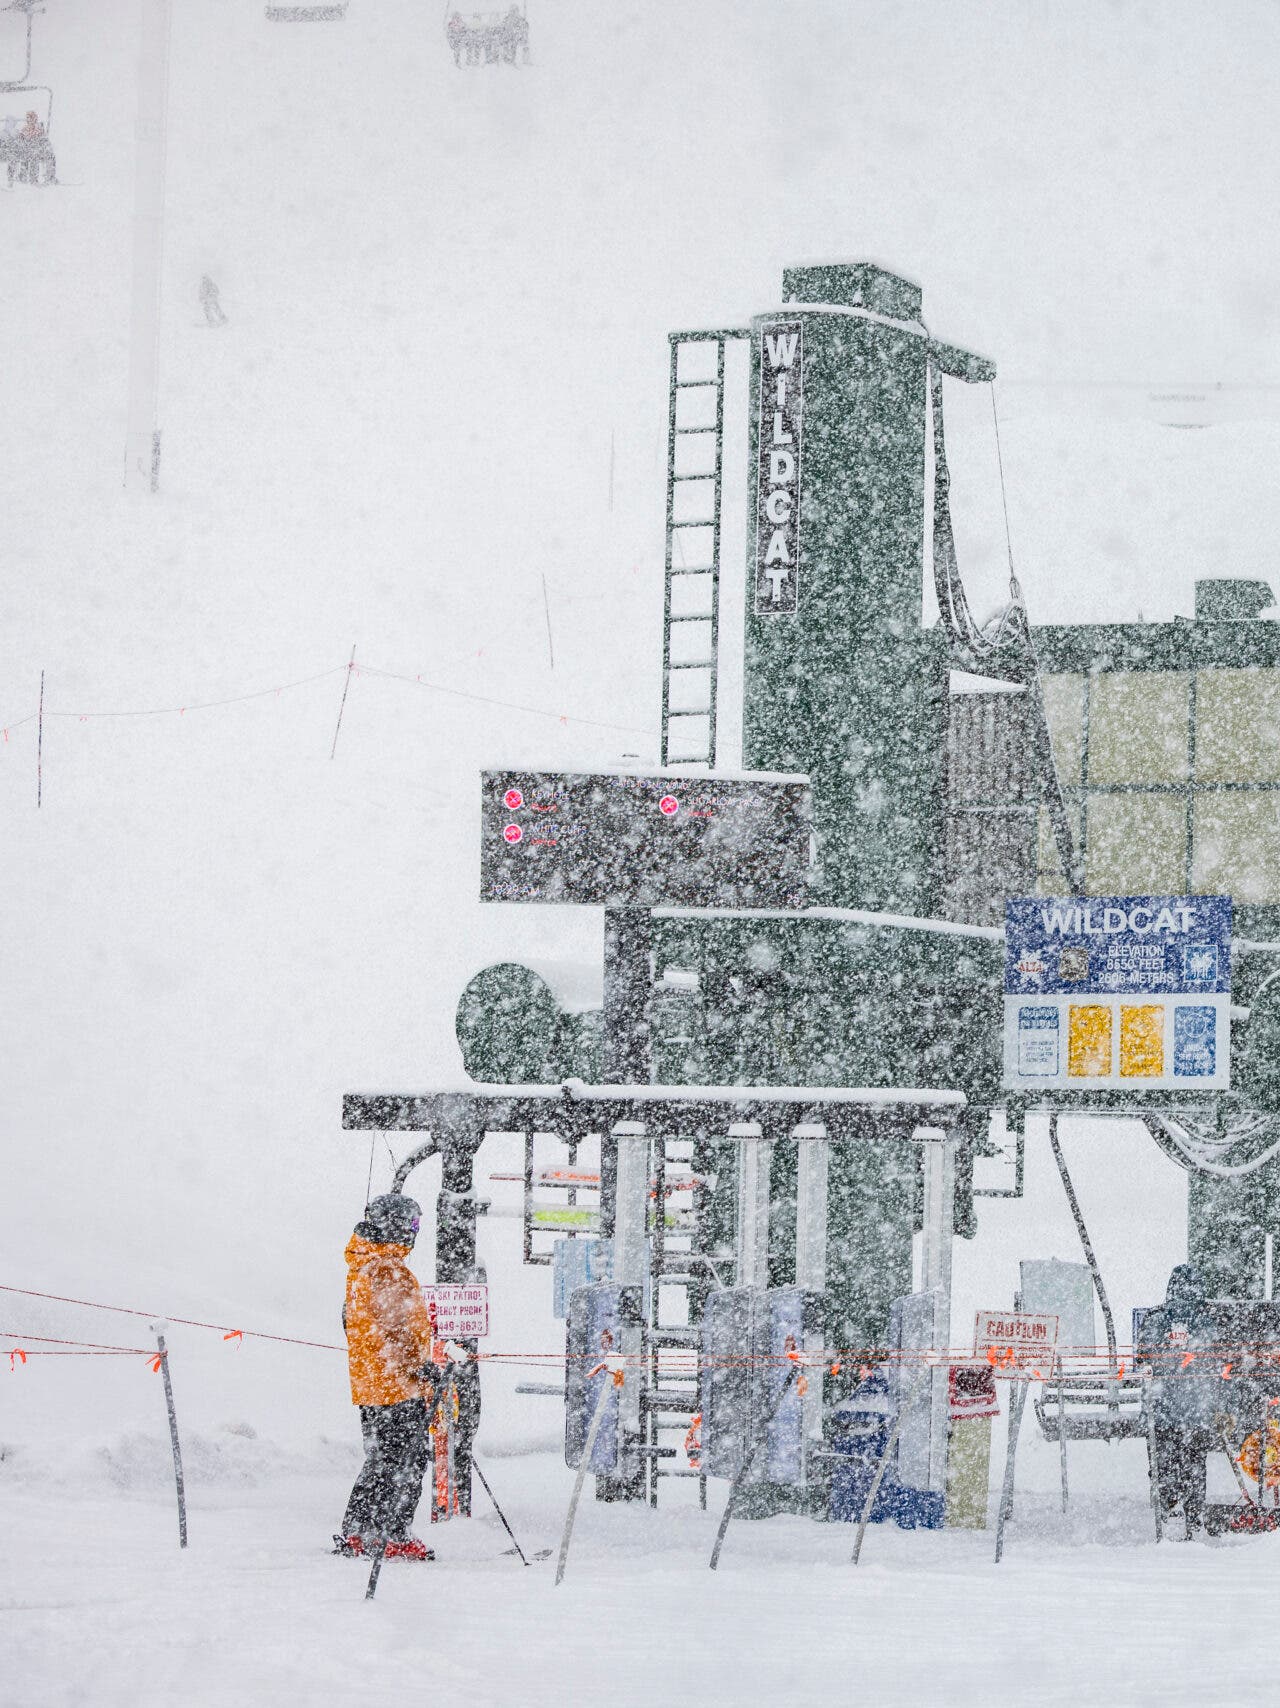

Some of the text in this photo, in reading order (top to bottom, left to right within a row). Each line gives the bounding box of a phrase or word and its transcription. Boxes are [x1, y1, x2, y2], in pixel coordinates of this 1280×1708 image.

[764, 333, 799, 602] WILDCAT
[1041, 906, 1197, 935] WILDCAT
[1108, 945, 1165, 957] ELEVATION
[1139, 958, 1166, 970] FEET
[1130, 972, 1175, 984] METERS
[438, 1290, 450, 1301] SKI
[453, 1290, 482, 1301] PATROL
[459, 1305, 483, 1316] PHONE
